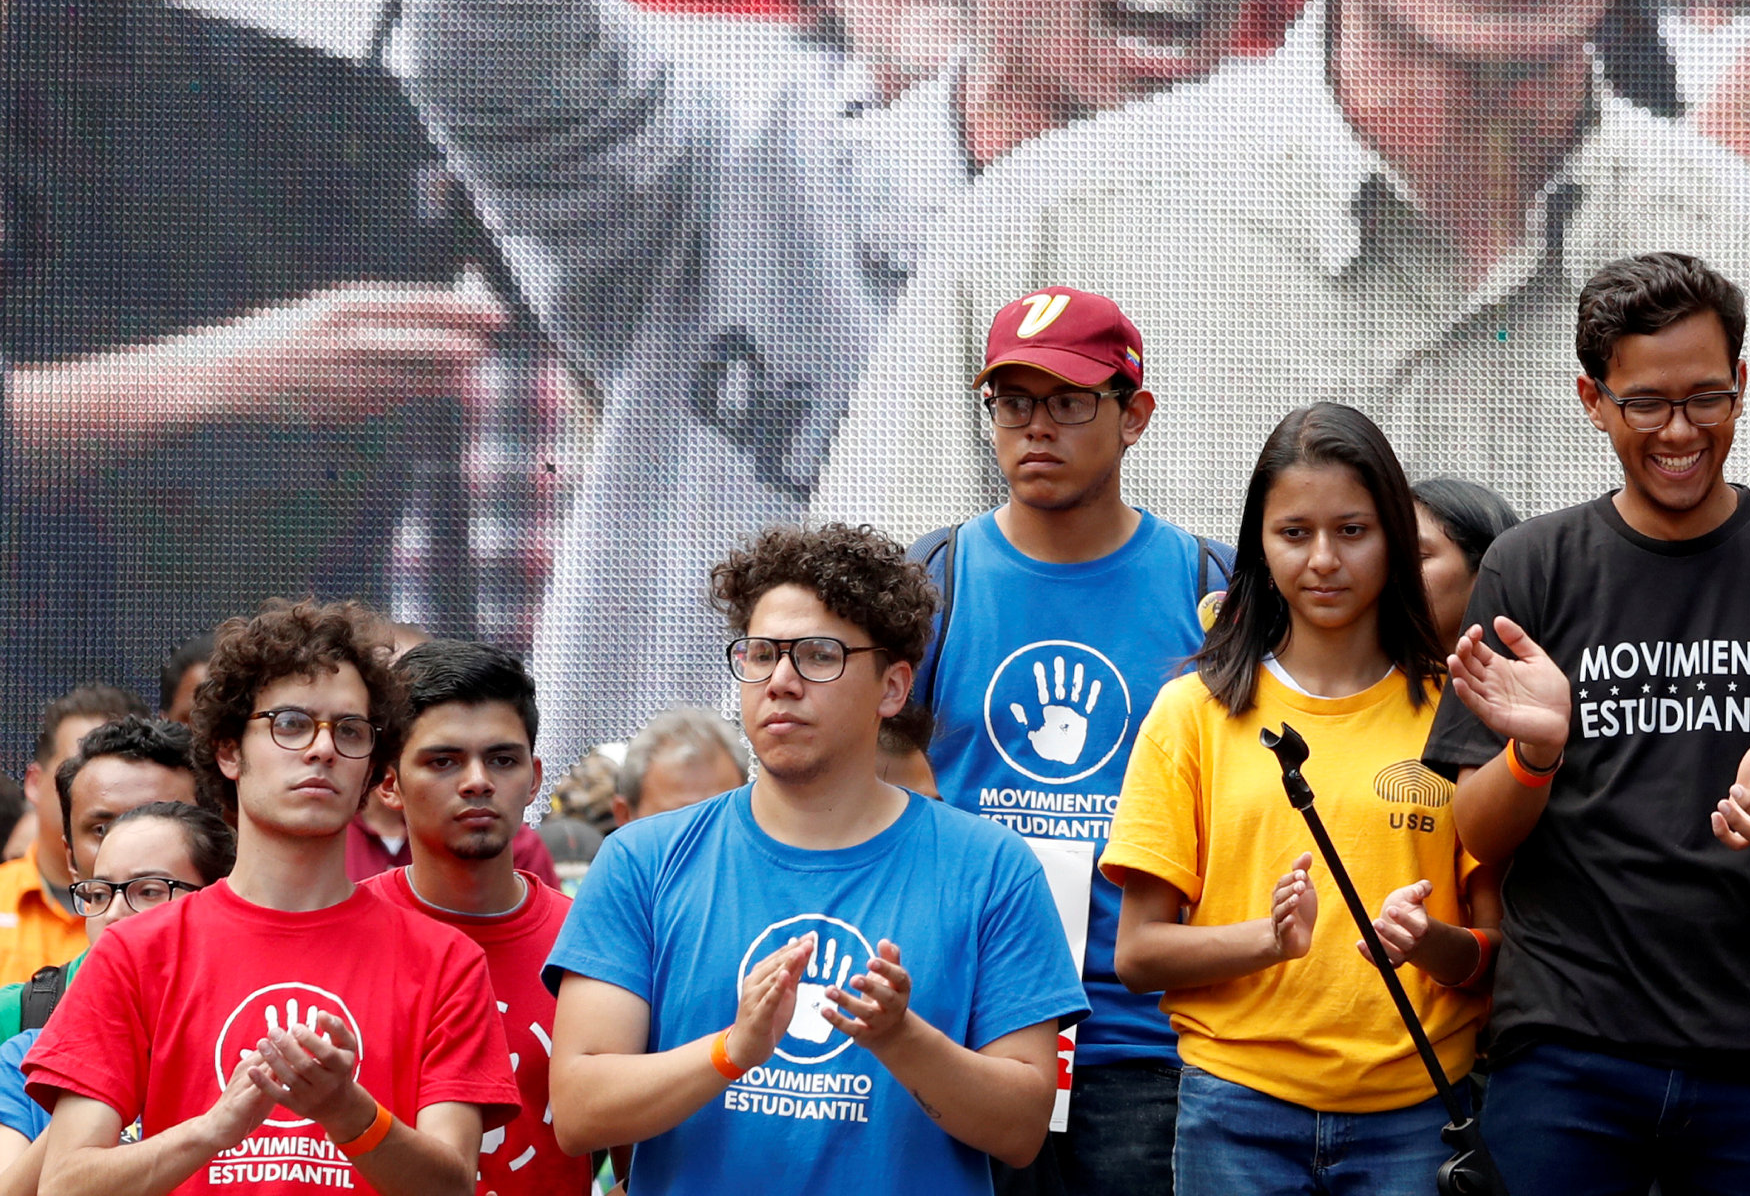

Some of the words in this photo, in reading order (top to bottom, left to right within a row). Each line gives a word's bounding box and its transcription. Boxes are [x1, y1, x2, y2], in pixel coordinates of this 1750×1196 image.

[1016, 293, 1072, 339] V
[979, 788, 1121, 814] MOVIMIENTO
[1389, 812, 1436, 833] USB
[724, 1090, 870, 1123] ESTUDIANTIL
[208, 1163, 355, 1189] ESTUDIANTIL
